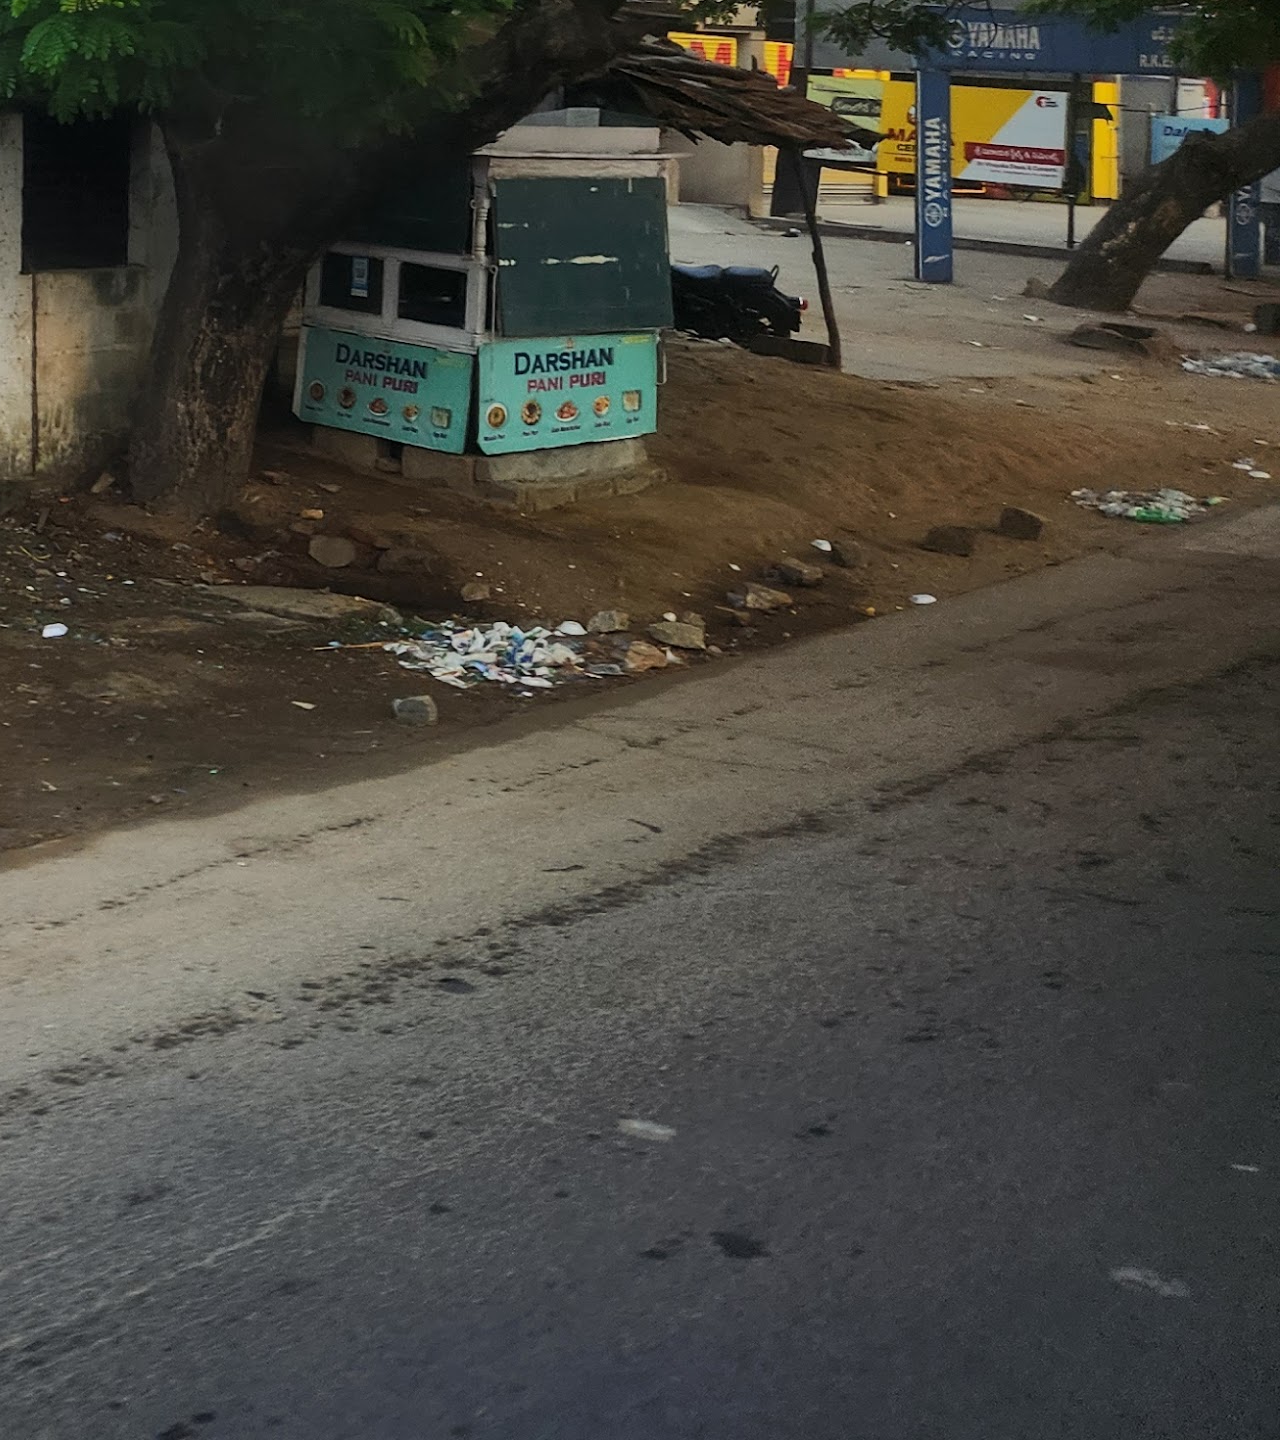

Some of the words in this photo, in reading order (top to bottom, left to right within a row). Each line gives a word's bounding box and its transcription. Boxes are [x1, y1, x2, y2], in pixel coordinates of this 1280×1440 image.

[966, 21, 1041, 50] YAMAHA
[924, 116, 942, 202] YAMAHA
[335, 343, 428, 379] DARSHAN
[513, 347, 615, 376] DARSHAN
[344, 369, 378, 387] PANI
[382, 376, 419, 394] PURI
[527, 376, 563, 393] PANI
[569, 371, 607, 389] PURI
